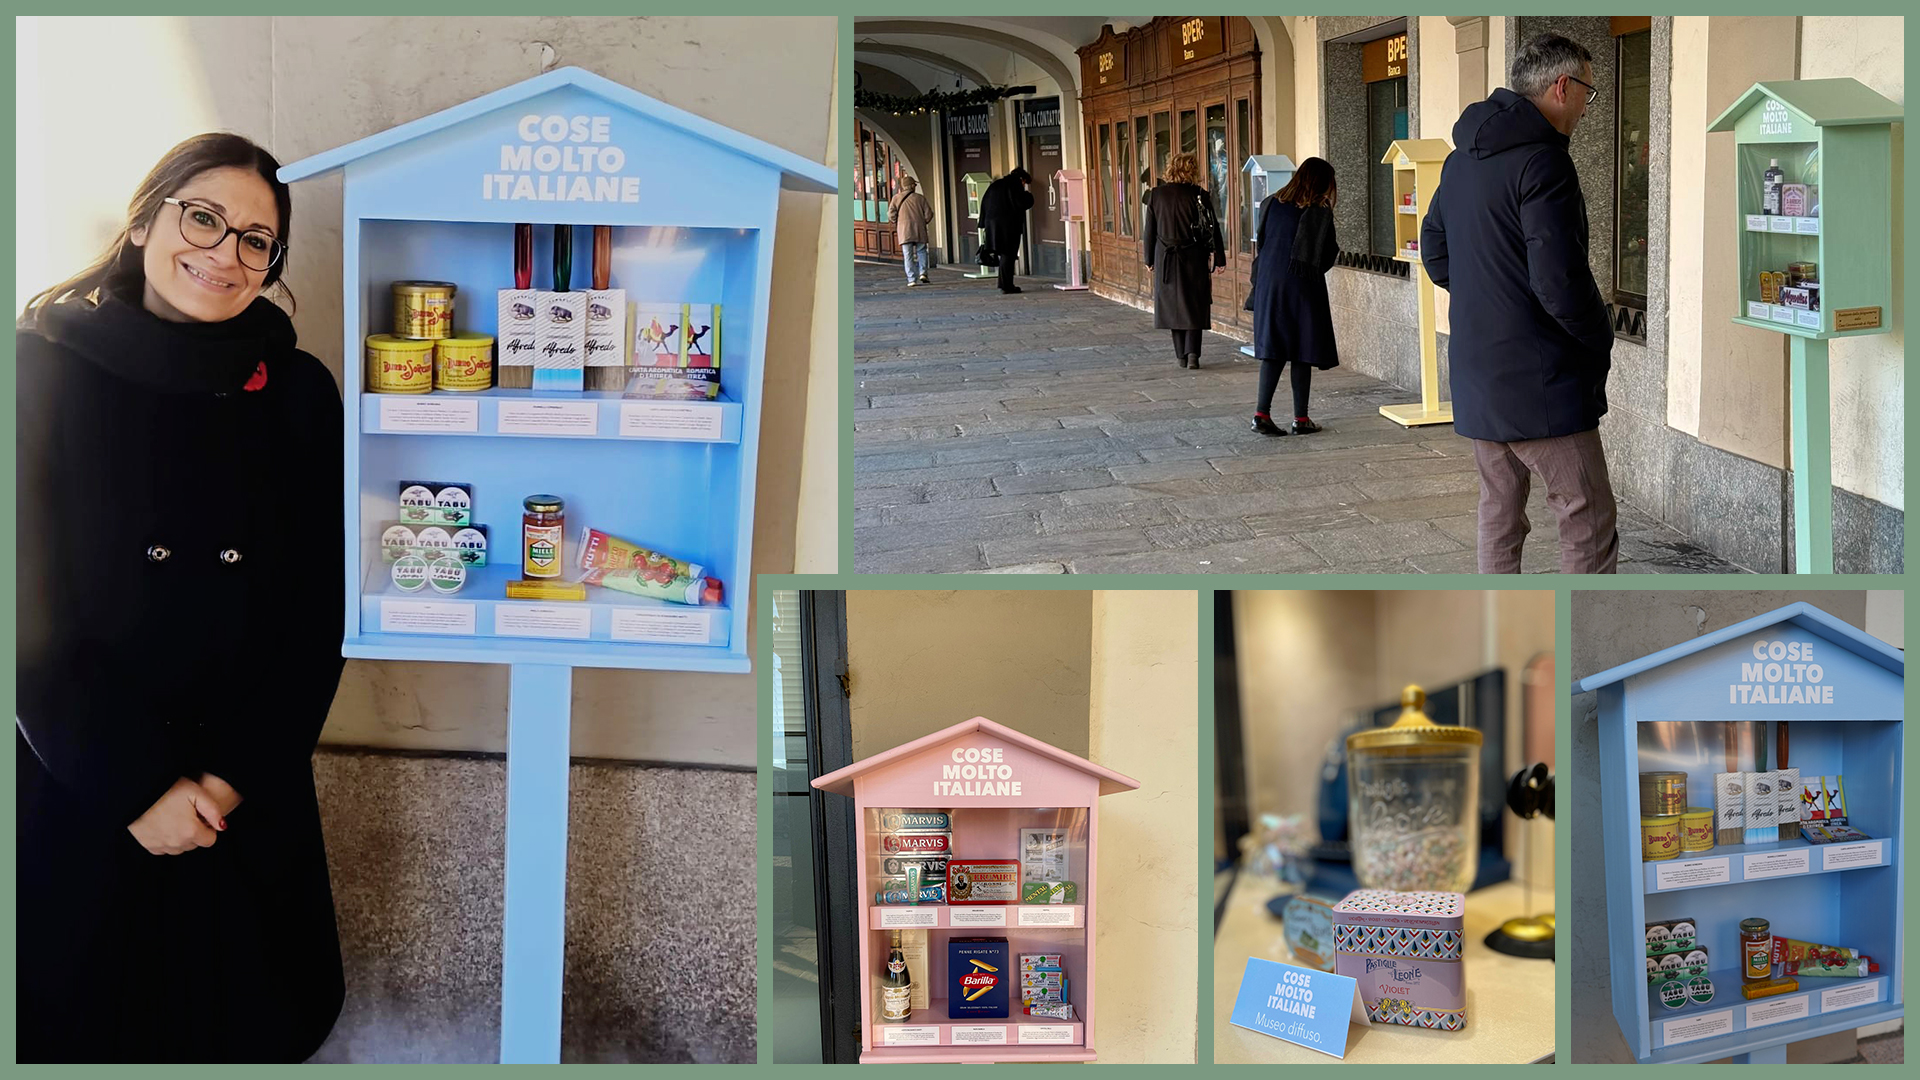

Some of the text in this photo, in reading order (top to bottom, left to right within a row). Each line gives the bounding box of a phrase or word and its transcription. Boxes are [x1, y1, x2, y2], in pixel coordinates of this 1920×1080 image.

[1181, 18, 1204, 45] BPER:
[1387, 36, 1408, 62] BPE
[1387, 65, 1400, 76] Banca
[1019, 112, 1032, 128] LENTI
[1033, 113, 1036, 127] A
[1763, 111, 1788, 123] MOLTO
[517, 115, 611, 143] COSE
[946, 116, 967, 135] OTTICA
[1760, 123, 1792, 135] ITALIANE
[500, 145, 626, 172] MOLTO
[483, 175, 640, 203] ITALIANE
[542, 341, 577, 357] Alfredo
[584, 339, 616, 354] Alfredo
[584, 537, 600, 570] MUTTI
[434, 568, 461, 576] TABU
[1753, 640, 1813, 661] COSE
[1741, 662, 1824, 683] MOLTO
[1730, 684, 1834, 704] ITALIANE
[951, 747, 1003, 763] COSE
[942, 764, 1013, 780] MOLTO
[933, 781, 1022, 796] ITALIANE
[901, 816, 944, 825] MARVIS
[1751, 808, 1774, 820] Alfredo
[902, 839, 944, 848] MARVIS
[902, 890, 938, 900] MRVIS
[1024, 884, 1048, 902] MENTAL
[1773, 940, 1781, 965] MUTTI
[1366, 958, 1397, 974] PASTIGLIE
[964, 976, 994, 985] Barilla
[1283, 970, 1311, 988] COSE
[1393, 967, 1422, 982] LEONE
[1274, 983, 1313, 1003] MOLTO
[1379, 984, 1410, 995] VIOLET
[1267, 995, 1316, 1019] ITALIANE
[1254, 1012, 1322, 1044] Museo diffuso.
